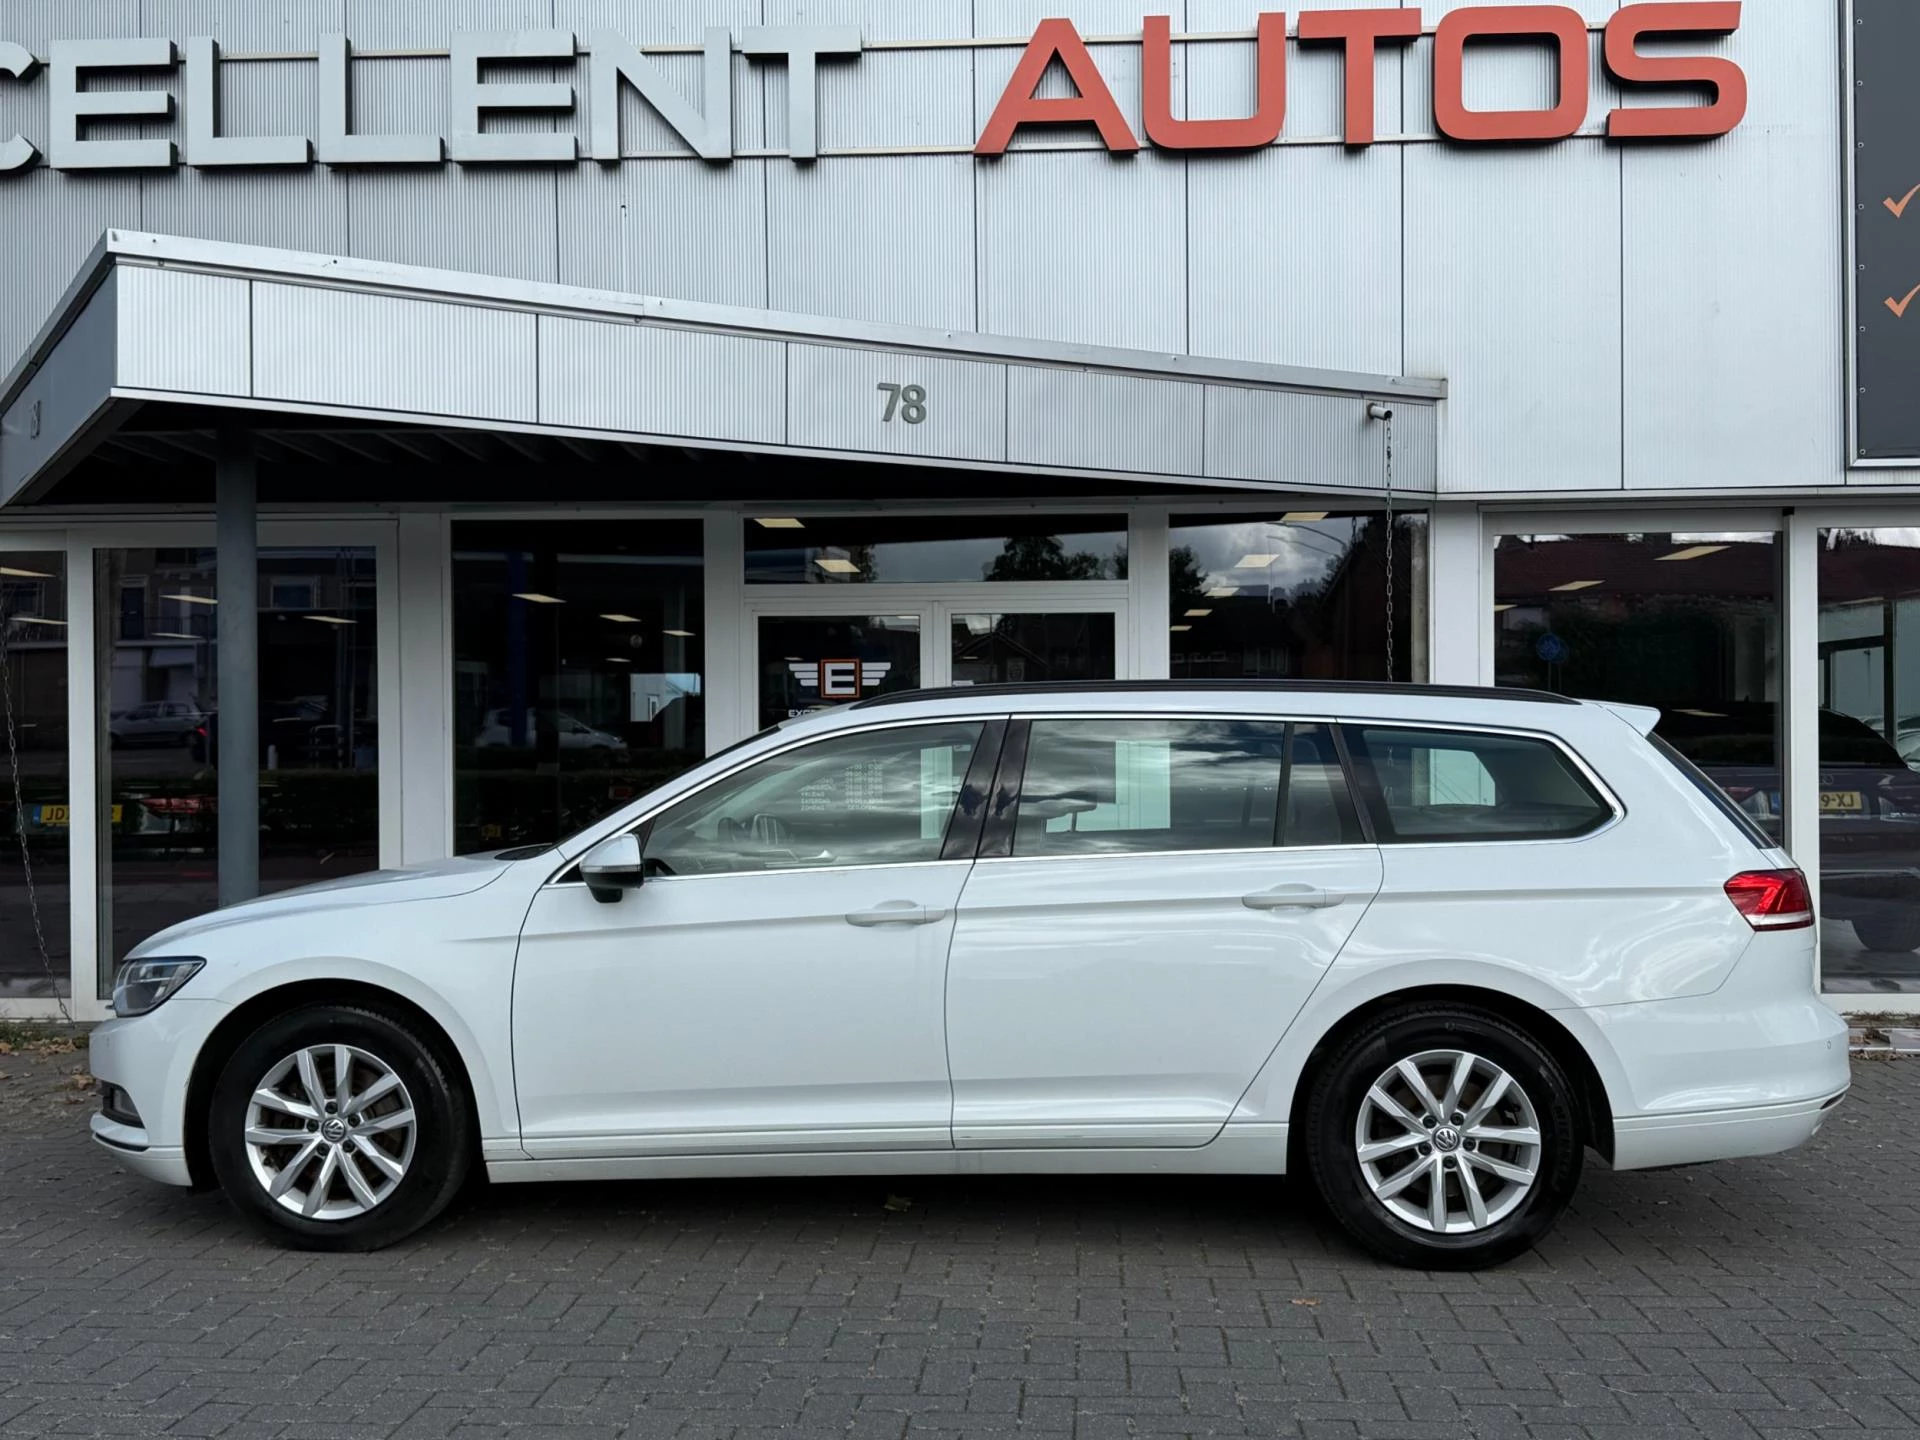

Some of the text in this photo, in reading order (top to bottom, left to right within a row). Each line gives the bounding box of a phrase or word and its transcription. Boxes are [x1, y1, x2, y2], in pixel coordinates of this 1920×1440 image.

[0, 1, 1748, 171] ELLENT AUTOS
[877, 383, 926, 424] 78
[825, 662, 855, 694] E
[46, 807, 69, 821] JD
